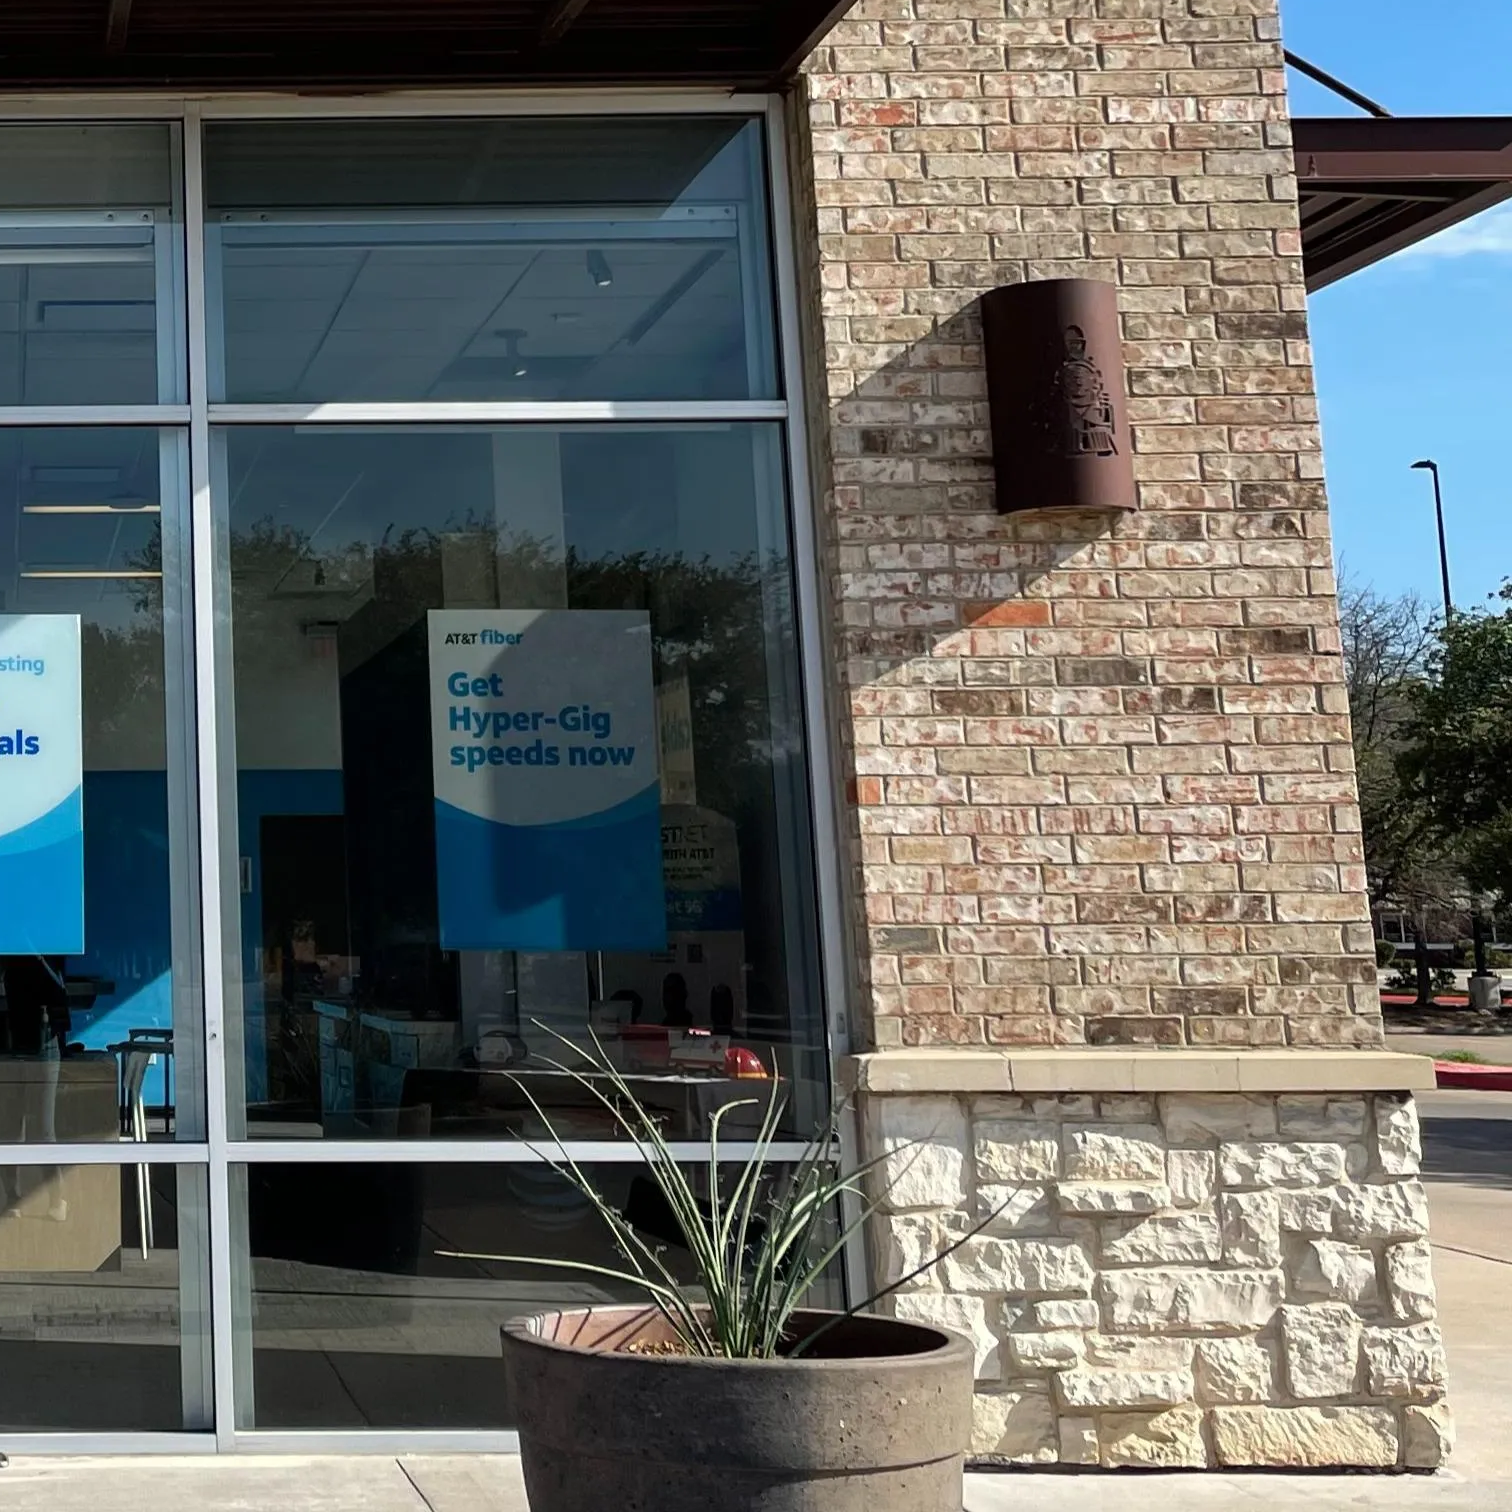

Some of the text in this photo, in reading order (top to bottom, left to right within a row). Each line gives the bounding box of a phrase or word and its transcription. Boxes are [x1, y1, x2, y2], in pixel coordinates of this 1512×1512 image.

[445, 629, 524, 645] AT&T fiber
[447, 672, 504, 698] Get
[449, 705, 611, 739] Hyper-Gig
[450, 739, 635, 773] speeds now
